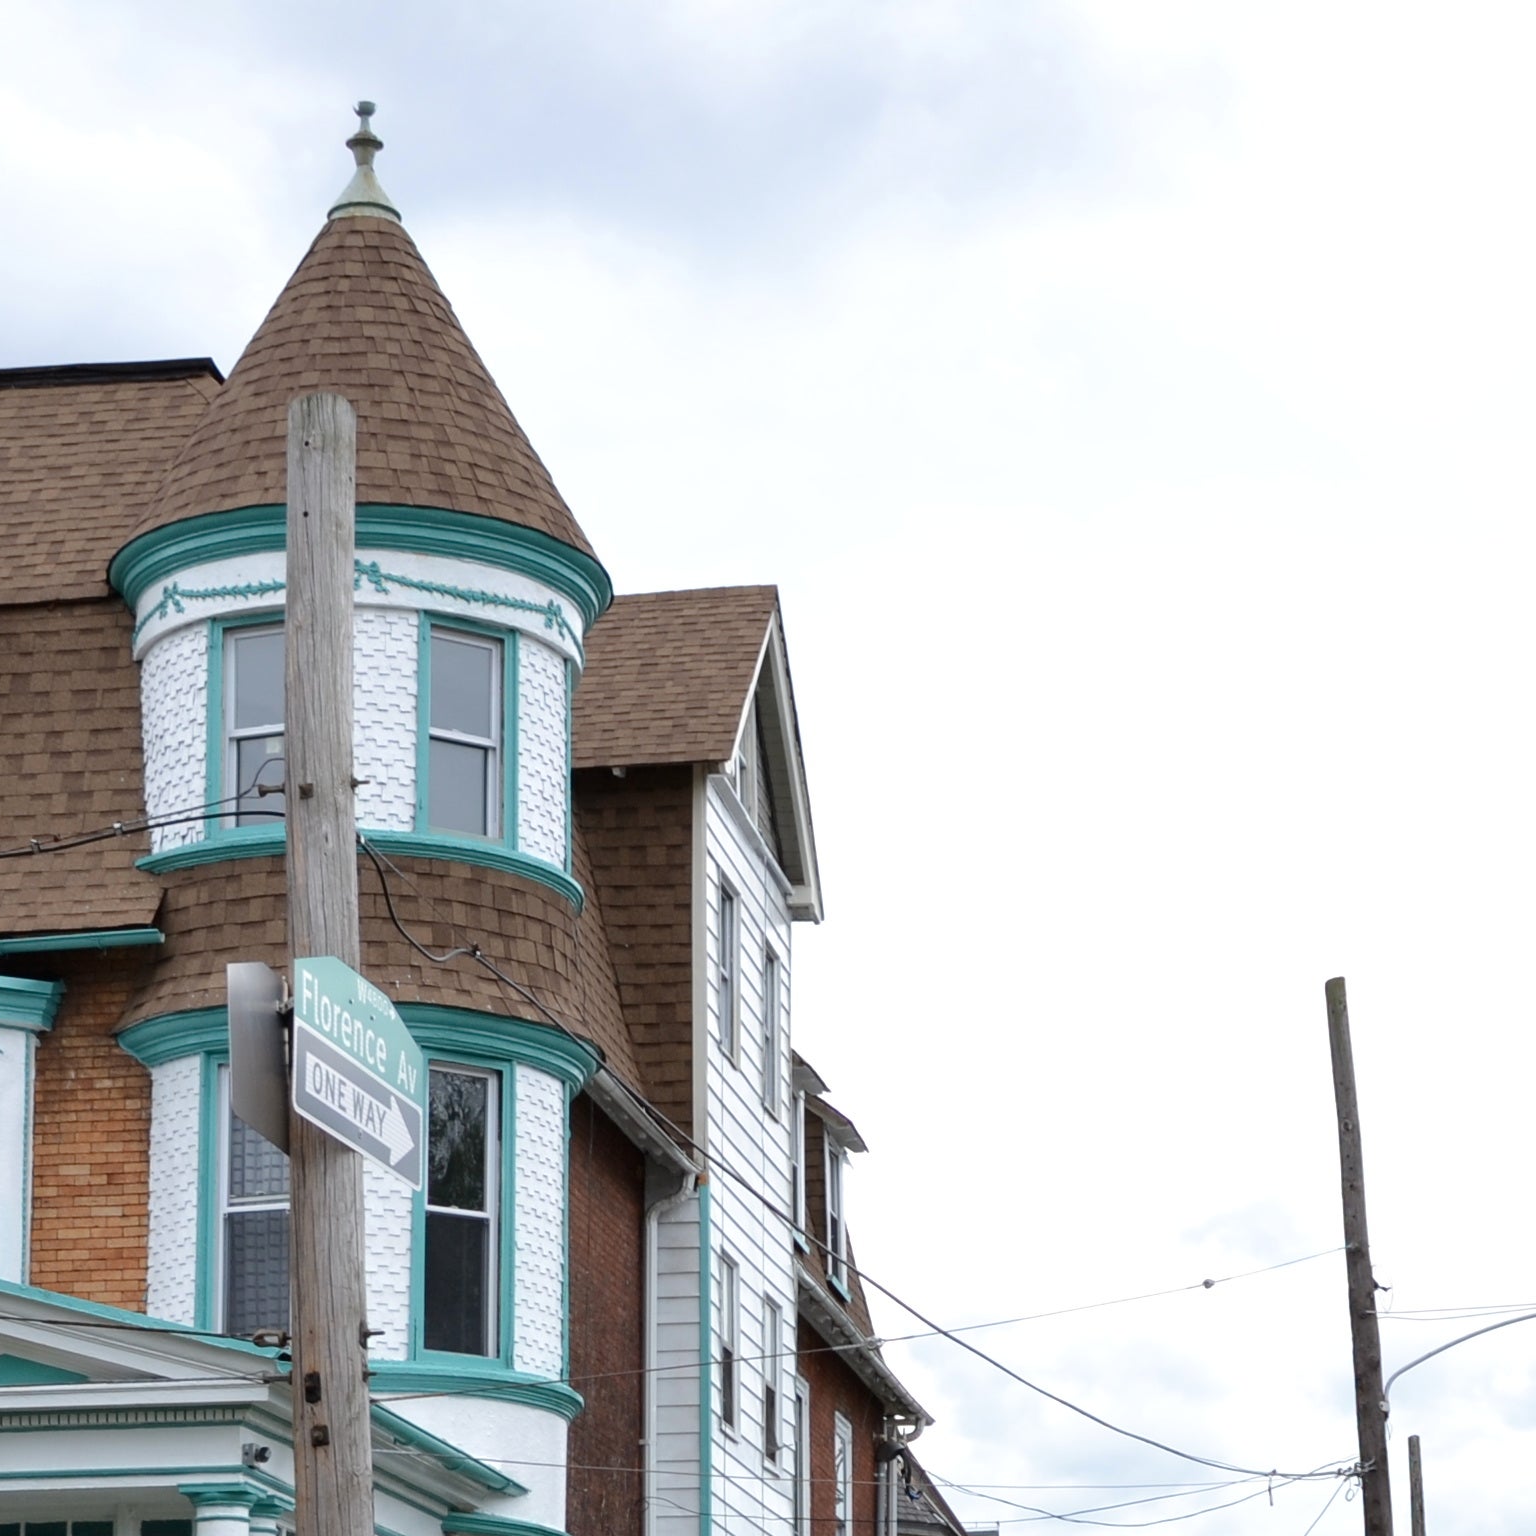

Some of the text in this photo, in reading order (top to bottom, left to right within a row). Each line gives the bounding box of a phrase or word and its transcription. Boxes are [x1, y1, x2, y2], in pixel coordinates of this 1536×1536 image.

[302, 968, 417, 1095] Florence Av
[312, 1061, 387, 1138] ONE WAY
